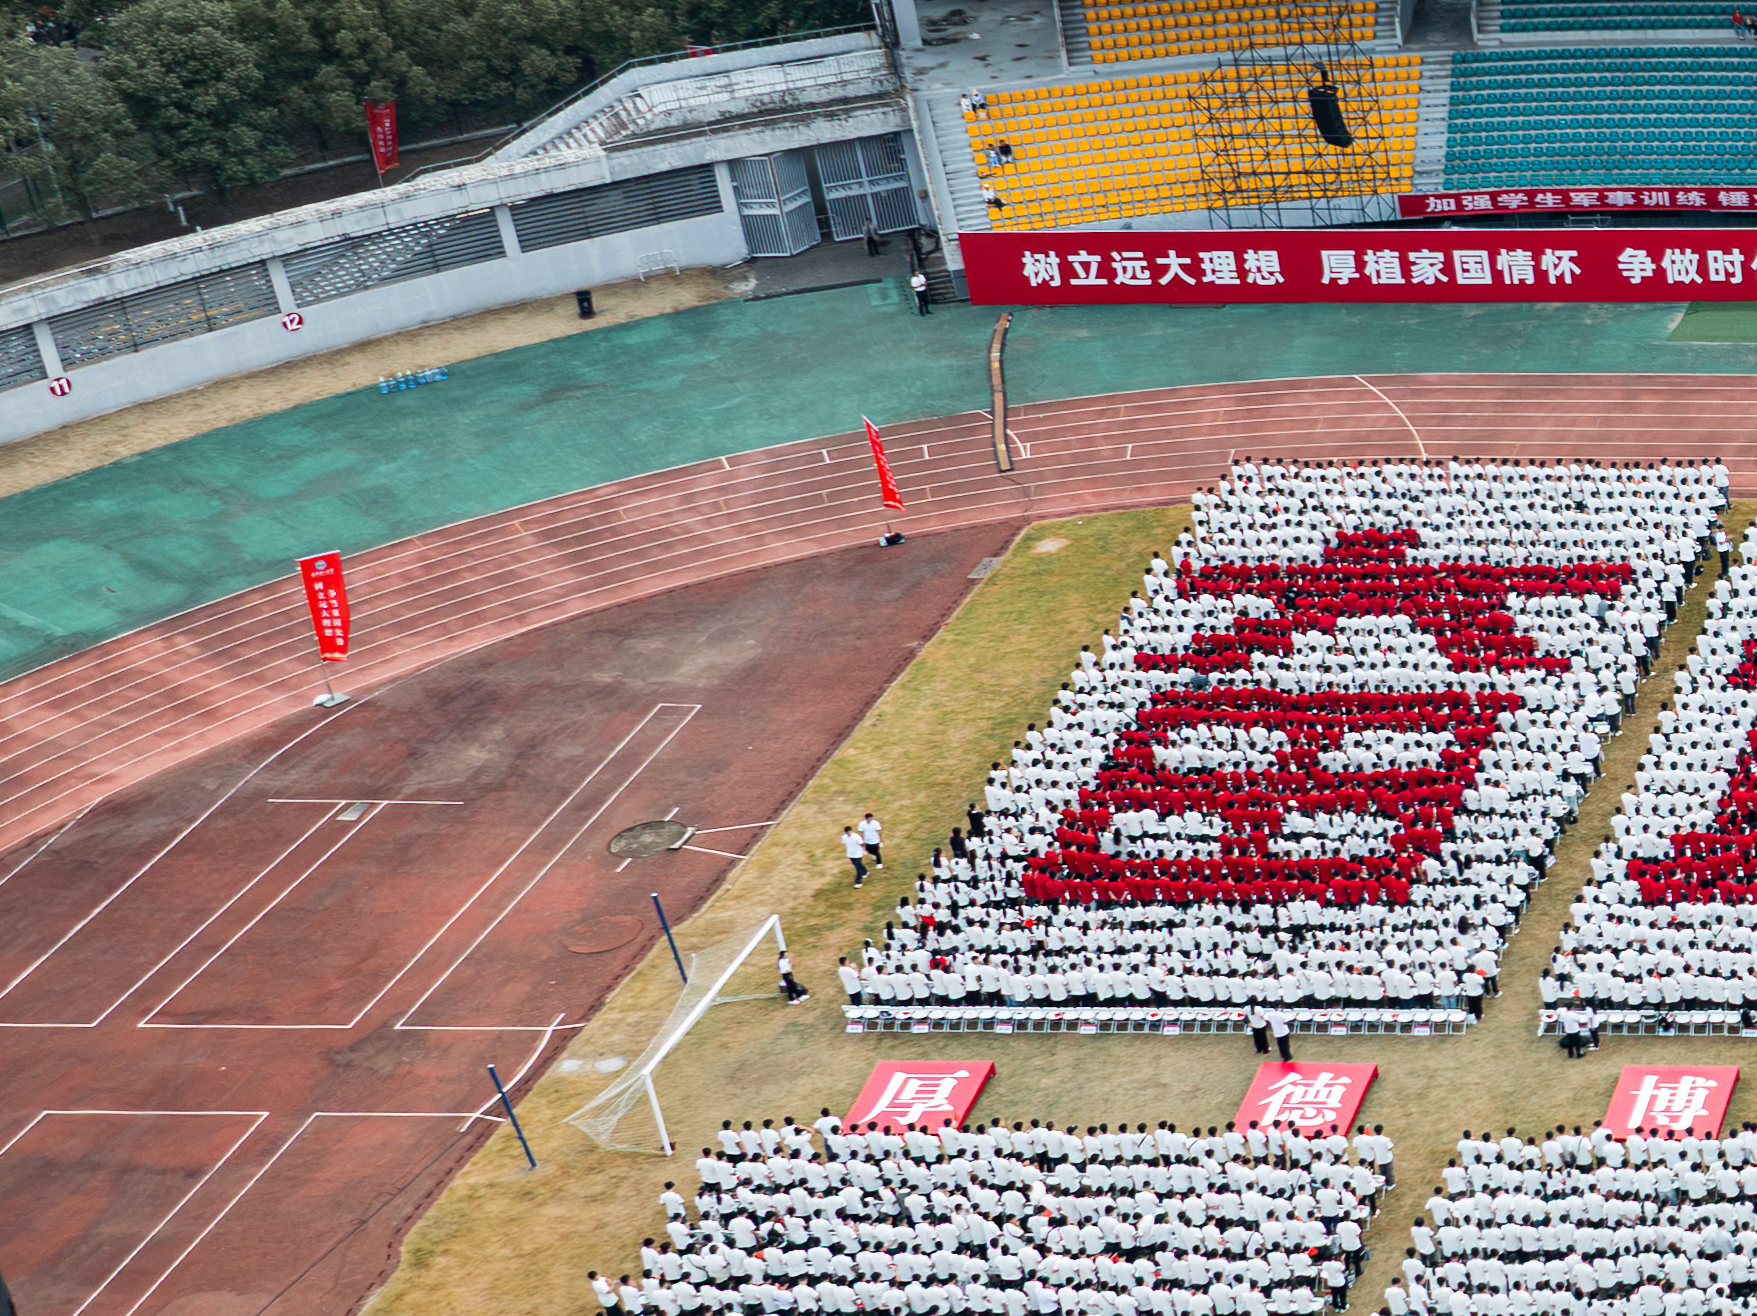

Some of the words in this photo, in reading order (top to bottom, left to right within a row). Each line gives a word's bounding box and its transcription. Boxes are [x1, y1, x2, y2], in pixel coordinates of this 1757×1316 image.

[1425, 190, 1706, 212] 加强学生军事训练
[1021, 248, 1285, 287] 树立远大理想
[1320, 248, 1582, 286] 厚植家国情怀
[283, 313, 301, 330] 12
[51, 379, 70, 395] 11
[860, 1069, 971, 1122] 厚
[1256, 1072, 1350, 1124] 德
[1629, 1075, 1717, 1128] 博
